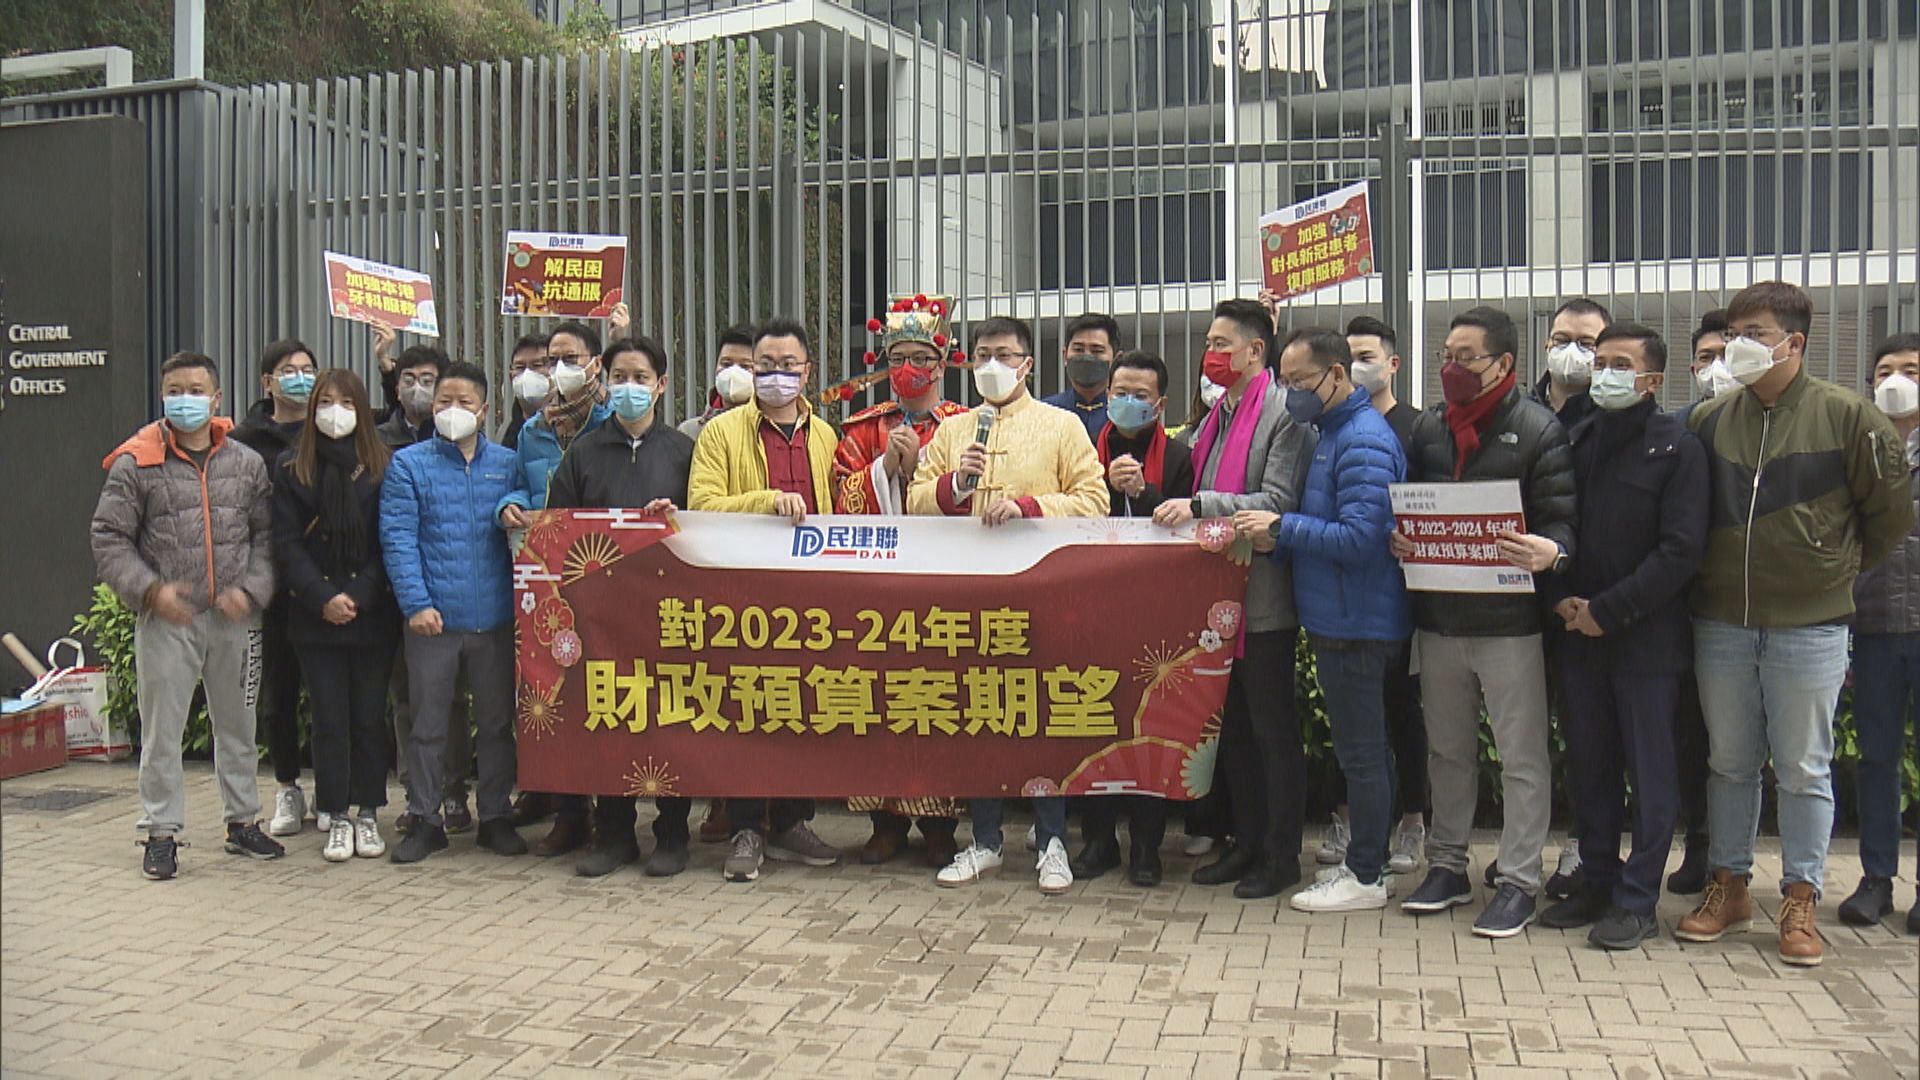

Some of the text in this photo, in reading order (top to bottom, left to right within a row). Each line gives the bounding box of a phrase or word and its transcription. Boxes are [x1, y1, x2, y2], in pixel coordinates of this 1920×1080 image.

[1298, 221, 1328, 246] 加強
[543, 256, 603, 280] 解民困
[345, 269, 416, 301] 加強本港
[8, 323, 72, 343] CENTRAL
[9, 349, 108, 369] GOVERNMENT
[10, 376, 67, 395] OFFICES
[827, 525, 899, 550] 民建聯
[1418, 520, 1483, 538] 2023-2024
[859, 550, 897, 560] DAB
[1414, 541, 1500, 561] 財政預算案期
[657, 597, 1032, 658] 對2023-24年度
[584, 658, 1122, 739] 財政預算案期望
